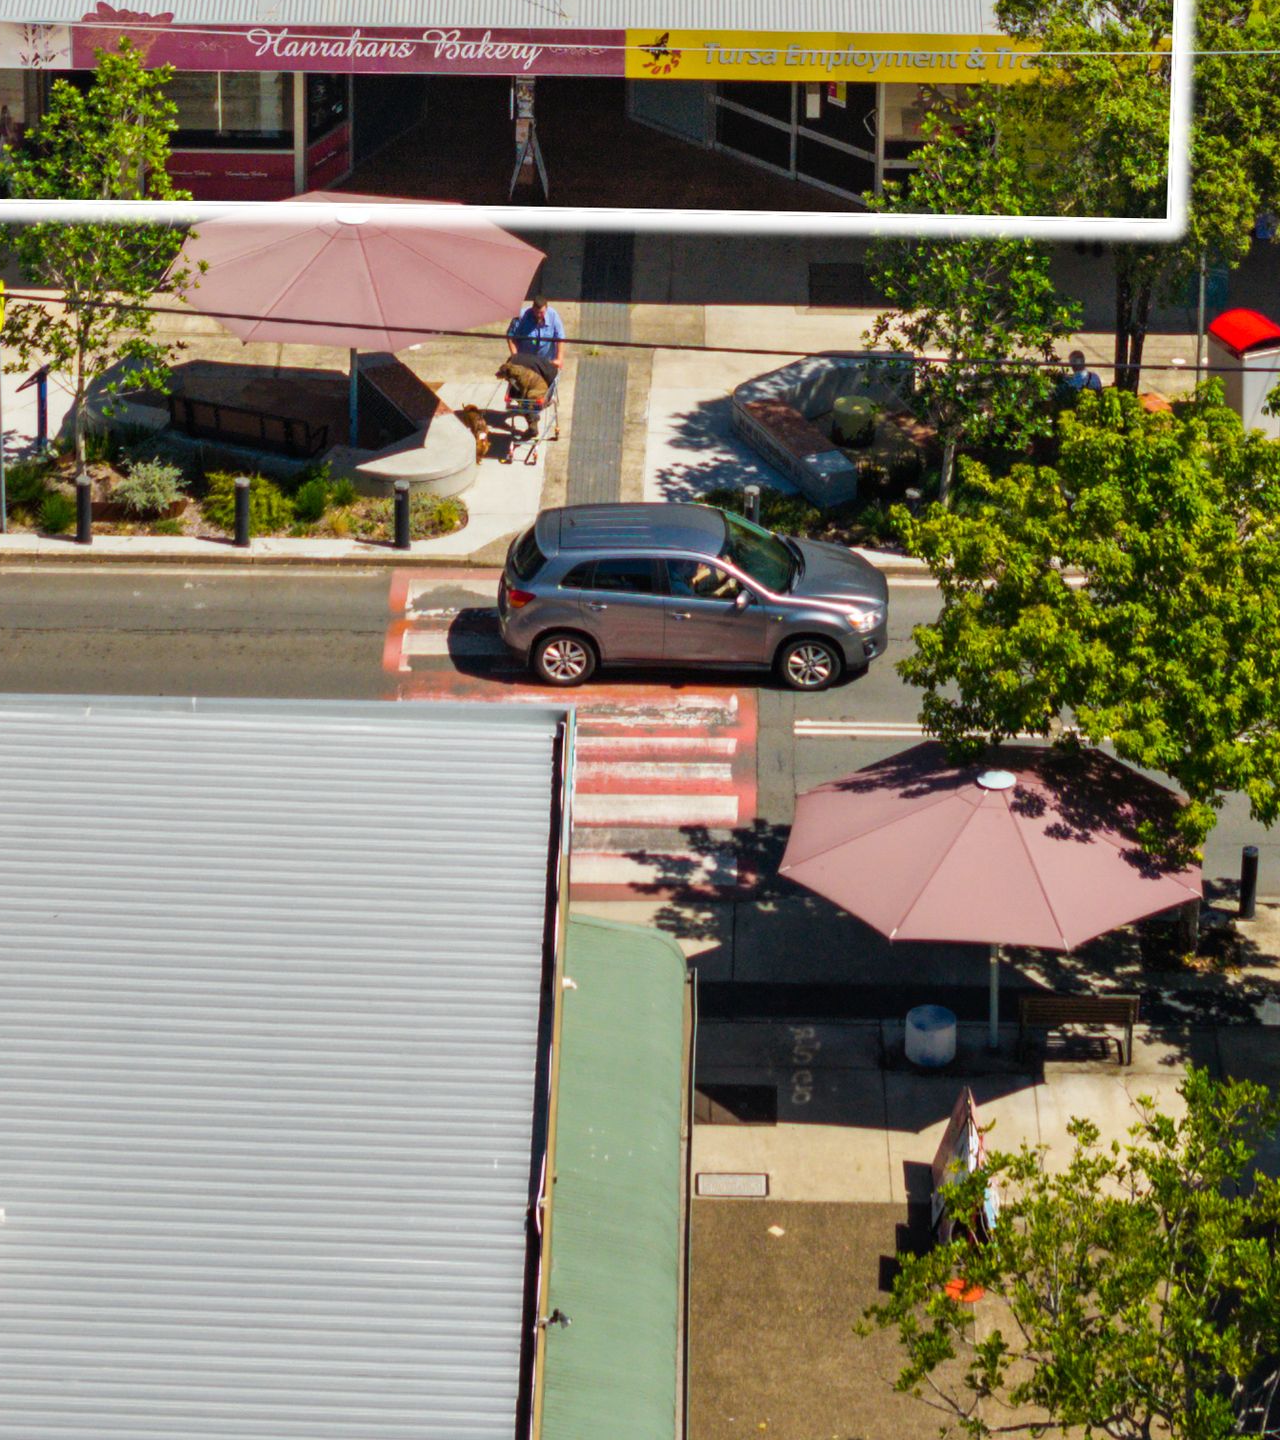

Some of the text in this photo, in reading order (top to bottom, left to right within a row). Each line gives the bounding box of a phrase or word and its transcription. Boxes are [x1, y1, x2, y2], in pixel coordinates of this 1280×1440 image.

[246, 27, 543, 69] Hanrahans Bakery
[704, 41, 778, 66] Tursa
[785, 42, 959, 74] Employment
[966, 46, 986, 69] &
